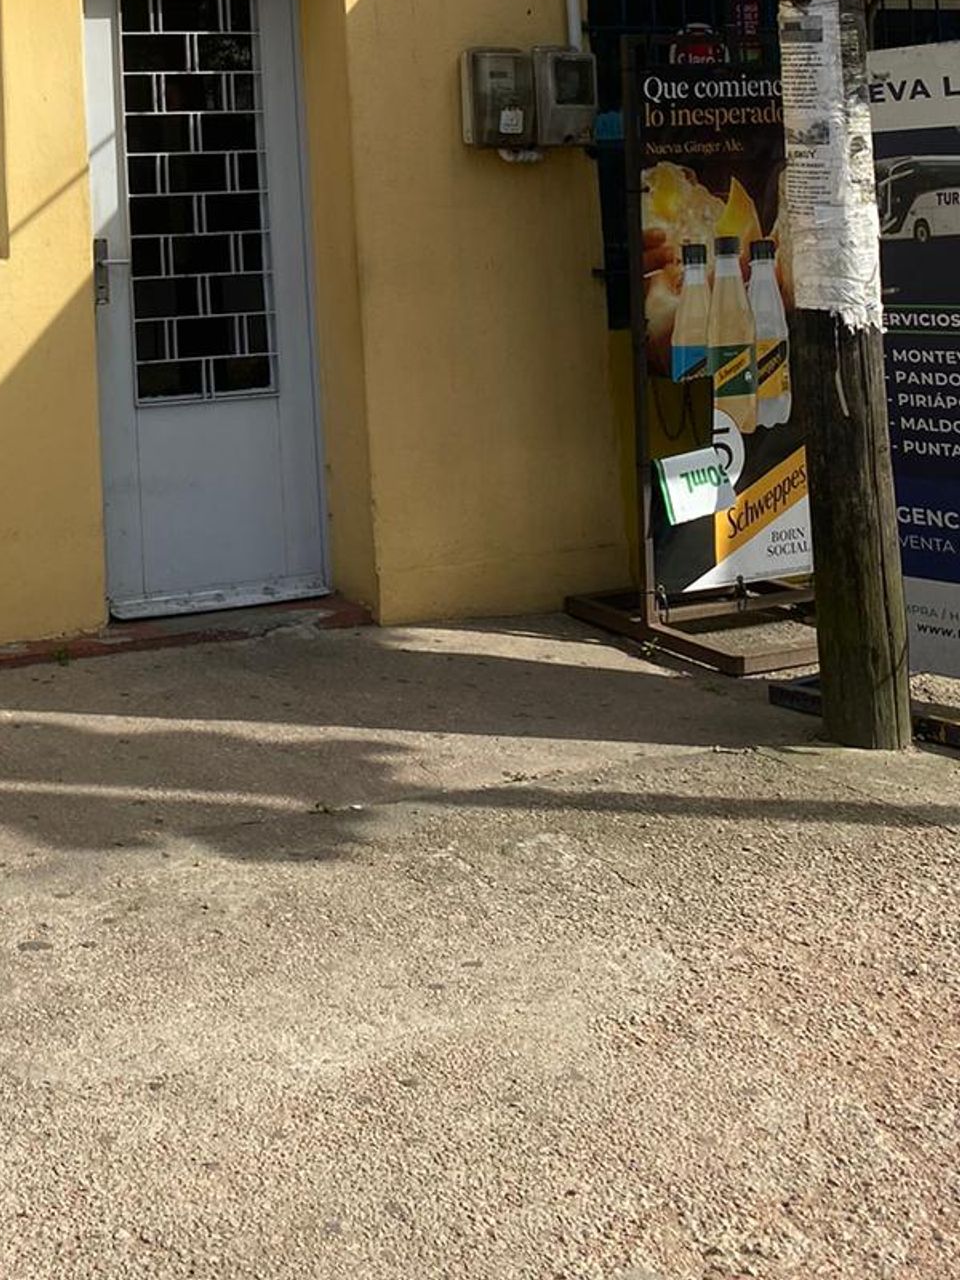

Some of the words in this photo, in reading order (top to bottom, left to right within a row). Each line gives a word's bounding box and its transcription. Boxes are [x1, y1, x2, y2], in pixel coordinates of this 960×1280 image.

[643, 76, 689, 103] Que
[644, 102, 665, 128] lo
[645, 142, 682, 155] Nueva
[683, 140, 721, 156] Ginger
[898, 392, 960, 410] PIRIÁP
[727, 464, 807, 539] Schweppes
[771, 527, 805, 543] BORN
[767, 540, 809, 558] SOCIAL
